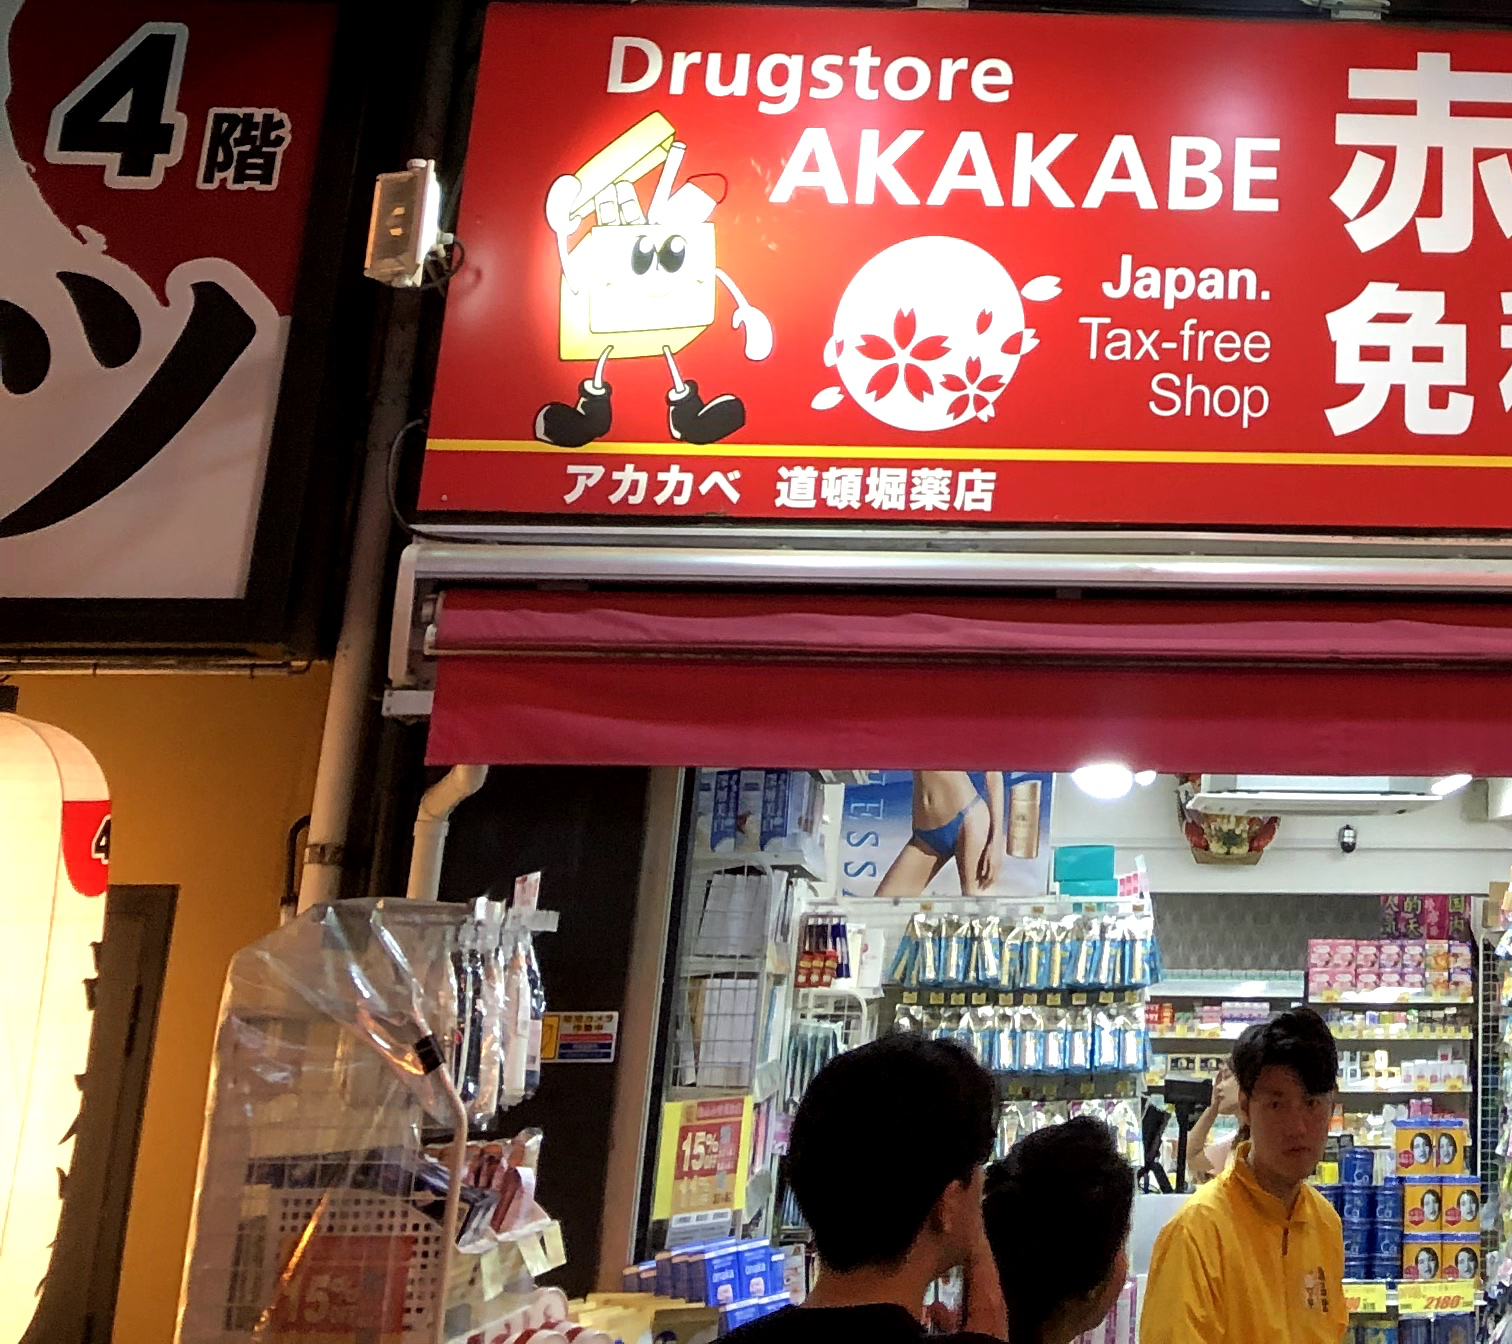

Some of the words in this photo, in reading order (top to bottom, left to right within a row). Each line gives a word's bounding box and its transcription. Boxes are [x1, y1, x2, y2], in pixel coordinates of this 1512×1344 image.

[52, 27, 289, 189] 4階
[606, 35, 1014, 115] Drugstore
[769, 126, 1282, 213] AKAKABE
[1101, 254, 1271, 311] Japan.
[1079, 316, 1271, 365] Tax-free
[1147, 372, 1271, 428] Shop
[563, 463, 743, 508] アカカベ
[774, 465, 997, 514] 道頓堀薬店
[842, 773, 886, 897] ESS
